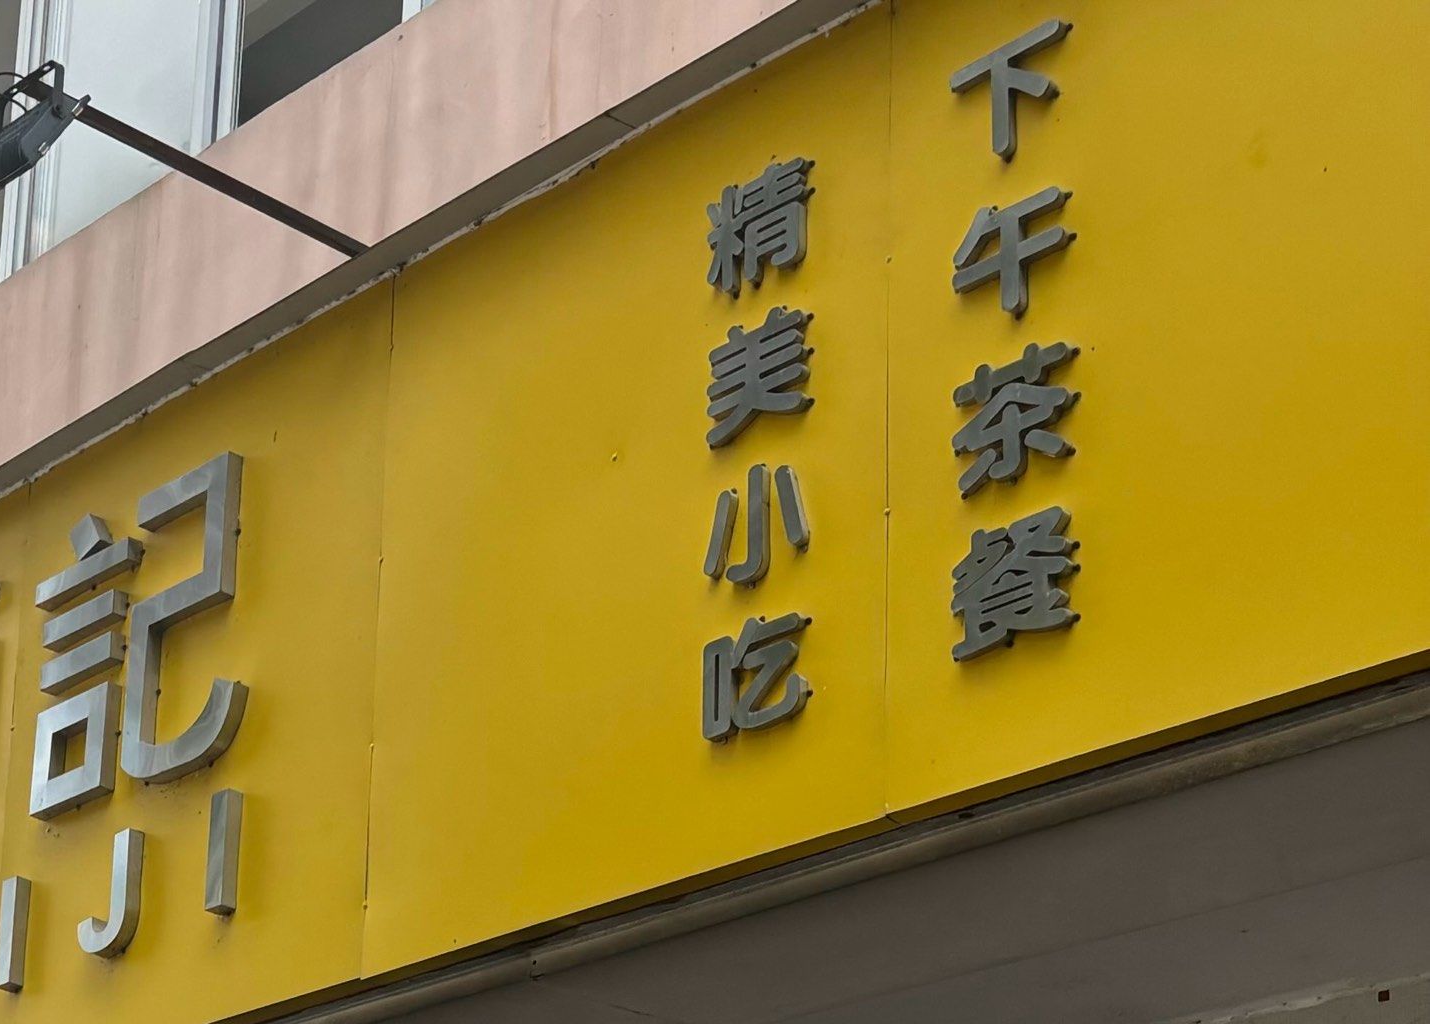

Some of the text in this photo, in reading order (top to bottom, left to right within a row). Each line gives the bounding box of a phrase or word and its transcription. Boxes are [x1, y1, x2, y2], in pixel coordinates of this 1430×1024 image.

[702, 156, 815, 742] 精美小吃
[951, 18, 1081, 661] 下午茶餐
